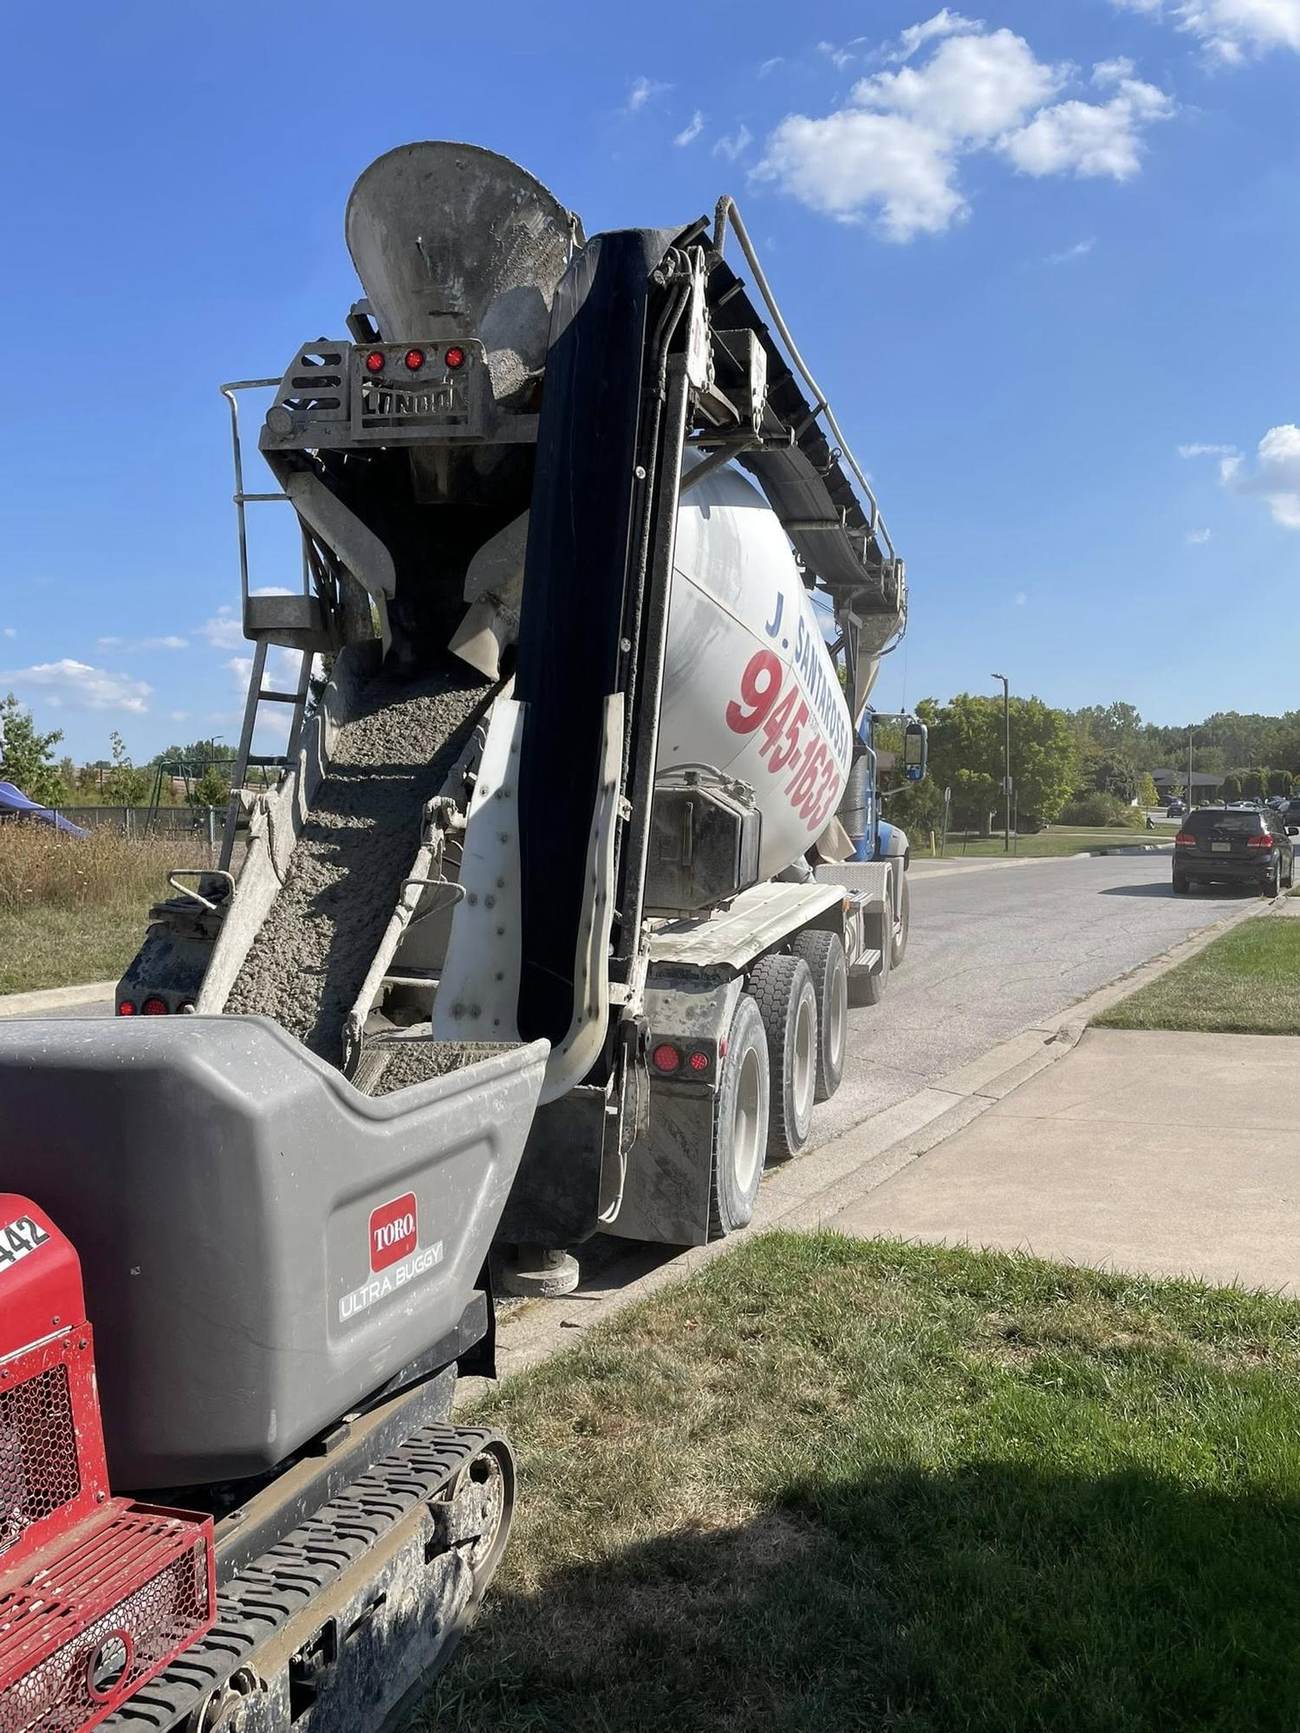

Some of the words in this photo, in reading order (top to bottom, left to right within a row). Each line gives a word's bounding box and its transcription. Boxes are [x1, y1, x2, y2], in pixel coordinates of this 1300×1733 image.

[725, 649, 841, 831] 945-1633
[765, 591, 789, 650] J.
[795, 615, 849, 769] SANTAROSSA
[341, 1277, 392, 1317] ULTRA
[396, 1244, 442, 1285] BUGGY
[374, 1213, 414, 1251] TORO
